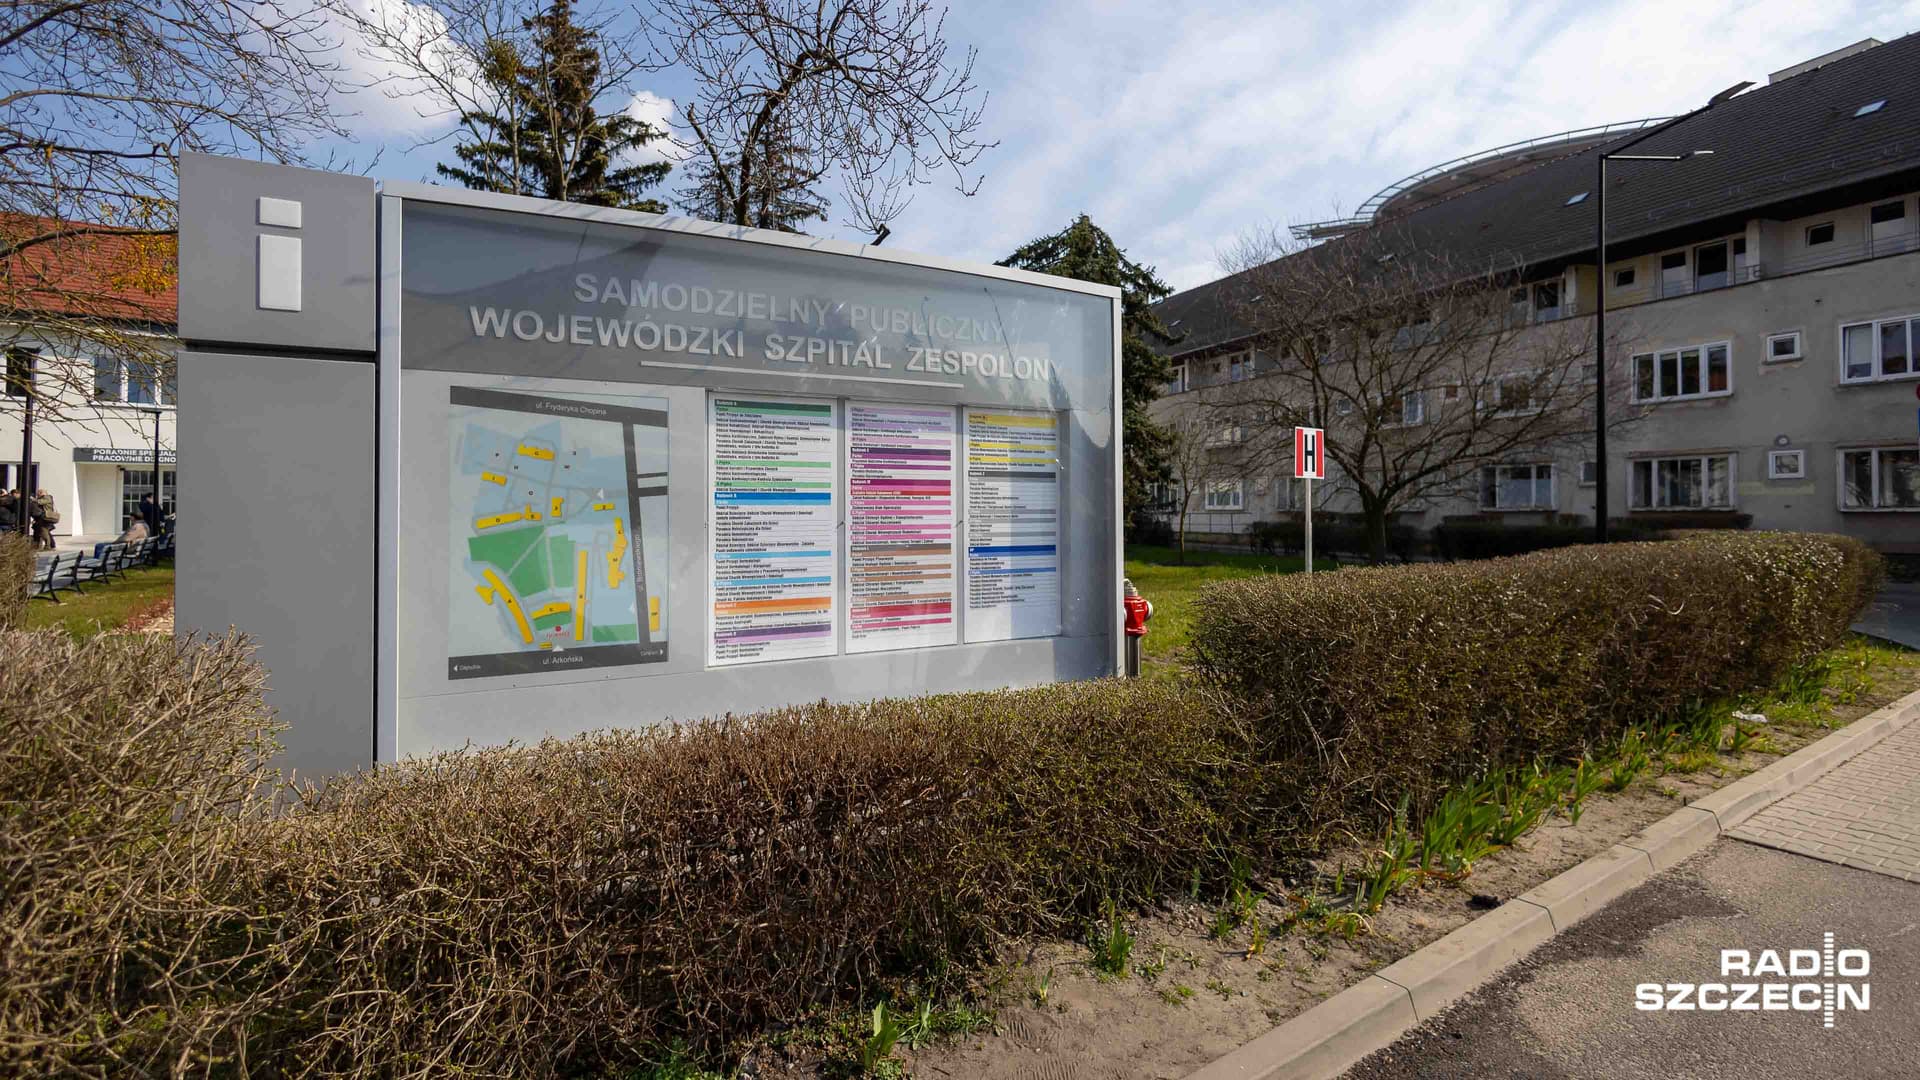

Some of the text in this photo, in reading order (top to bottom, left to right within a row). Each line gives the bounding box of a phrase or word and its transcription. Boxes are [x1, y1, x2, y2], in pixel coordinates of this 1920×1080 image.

[469, 305, 744, 358] WOJEWÓDZKI
[764, 333, 891, 369] SZPITAL
[575, 272, 1007, 343] SAMODZIELNY PUBLICZNY
[1304, 434, 1315, 473] H
